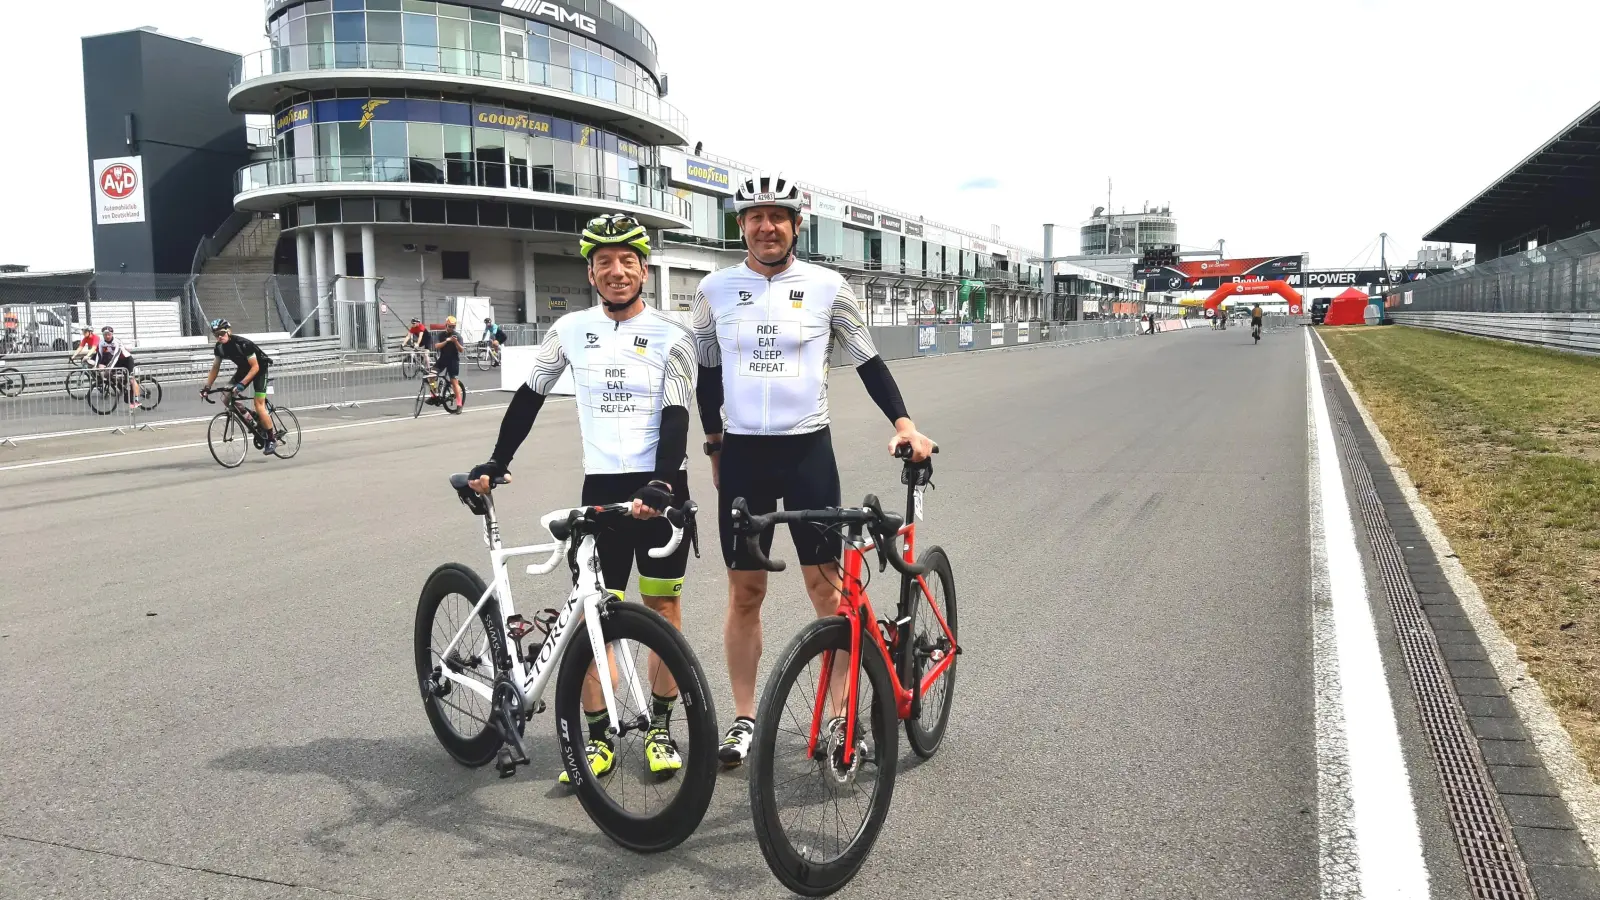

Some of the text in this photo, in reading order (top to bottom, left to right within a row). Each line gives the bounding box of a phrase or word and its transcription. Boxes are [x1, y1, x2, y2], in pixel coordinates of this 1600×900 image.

[535, 1, 597, 35] AMG
[277, 109, 308, 129] GOODYEAR
[478, 112, 549, 132] GOODYEAR
[688, 164, 728, 184] GOODYEAR
[1308, 273, 1356, 284] POWER
[485, 614, 501, 650] SWISS
[523, 598, 578, 694] STORCK
[560, 717, 584, 786] DT SWISS
